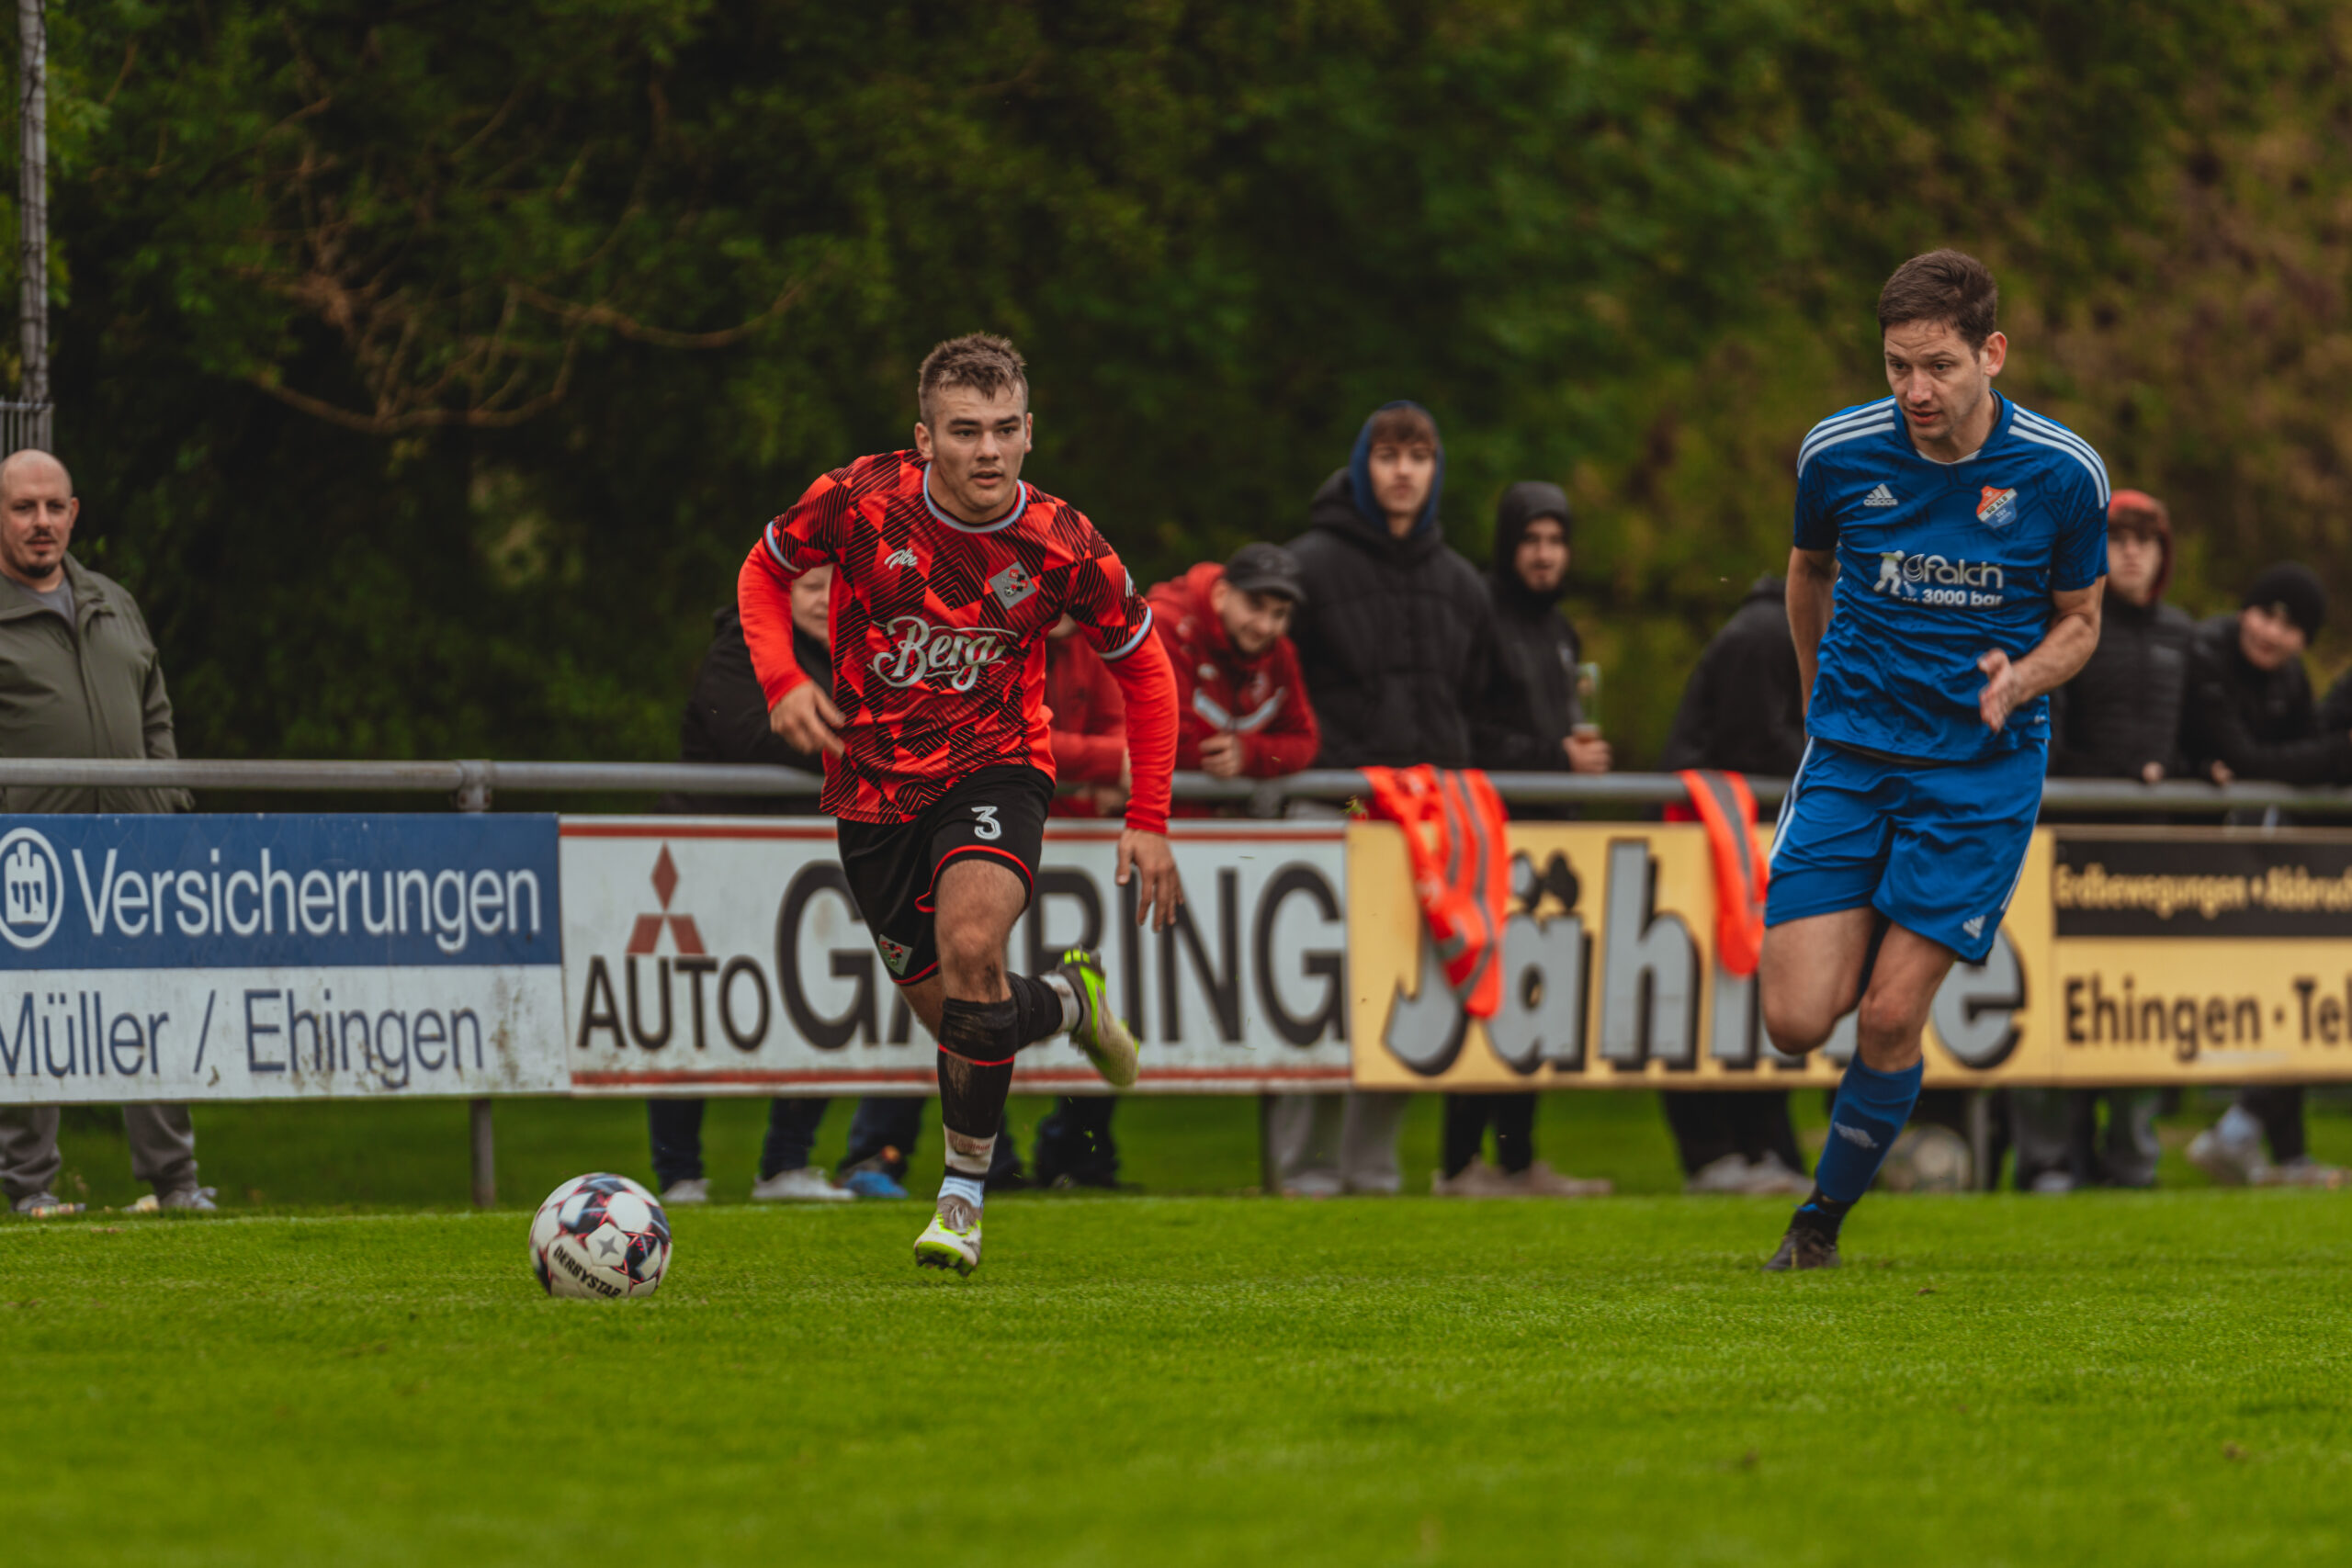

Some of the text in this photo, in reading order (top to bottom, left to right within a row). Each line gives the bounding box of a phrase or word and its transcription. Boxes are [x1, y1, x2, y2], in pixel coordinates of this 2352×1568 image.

[1922, 589, 1967, 604] 3000
[1970, 591, 2003, 606] bar
[867, 615, 1008, 691] Berg
[971, 806, 1002, 840] 3
[73, 847, 540, 954] Versicherungen
[577, 860, 1348, 1051] AUTO GRING
[0, 988, 483, 1089] Müller / Ehingen
[2064, 971, 2261, 1063] Ehingen
[553, 1244, 622, 1298] DERBYSTAR
